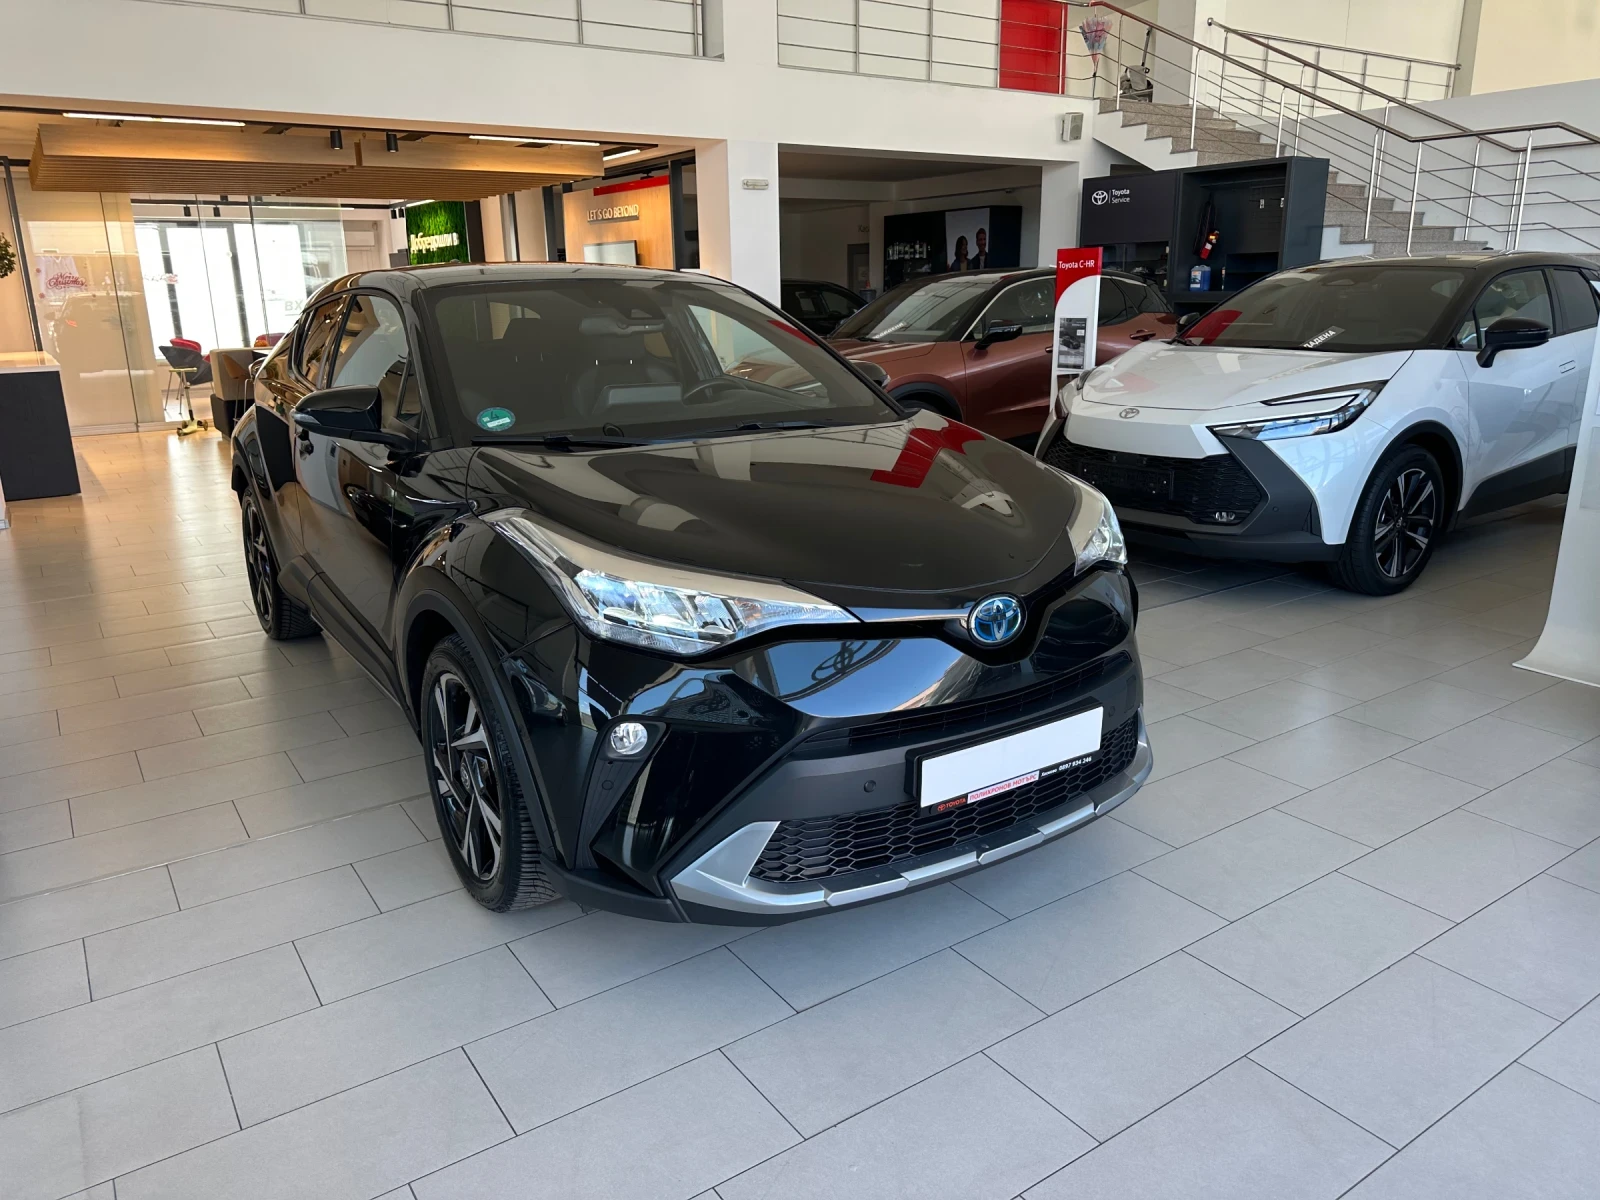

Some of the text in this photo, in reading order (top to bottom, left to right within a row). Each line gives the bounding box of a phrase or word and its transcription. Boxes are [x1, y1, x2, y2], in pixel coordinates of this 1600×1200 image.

[1112, 189, 1130, 197] Toyota
[602, 207, 613, 219] GO
[613, 204, 639, 218] BEYOND
[1058, 259, 1095, 270] Toyota C-HR
[946, 798, 966, 808] TOYOTA
[969, 782, 1011, 801] ПОЛИХРОНОВ
[1012, 773, 1037, 787] МОТЪРС
